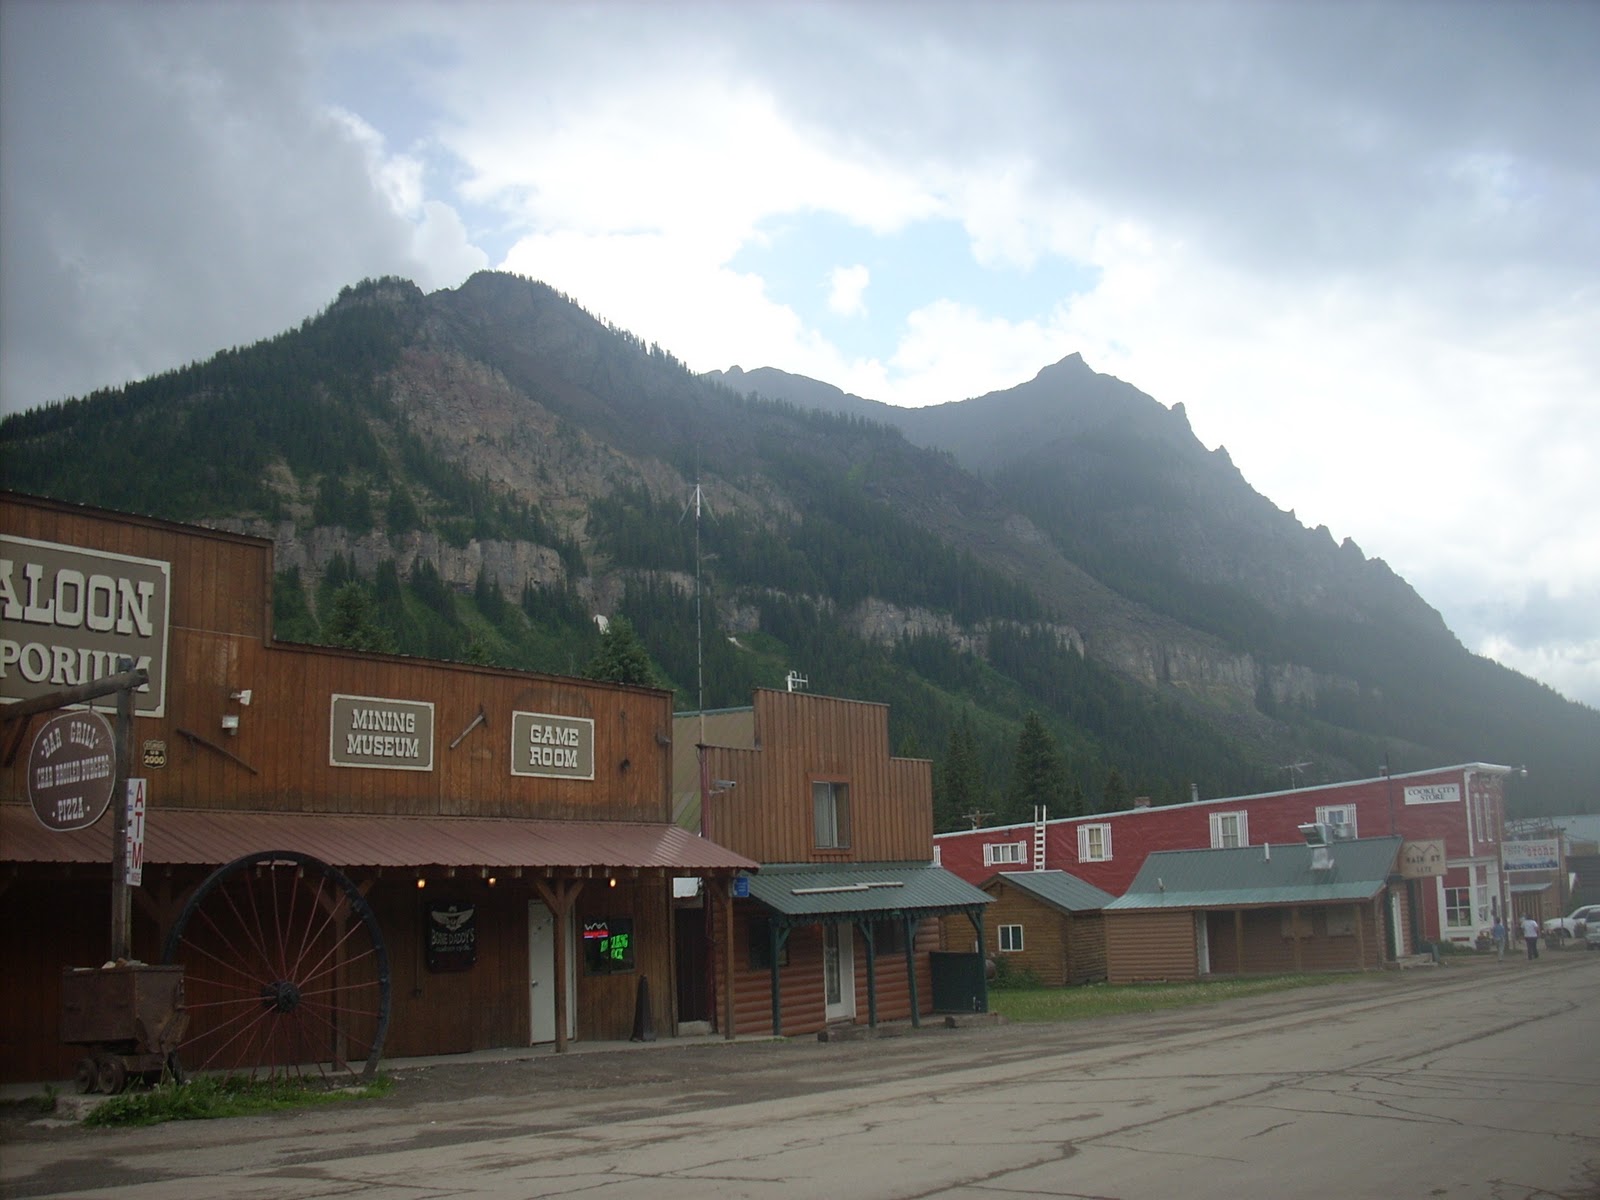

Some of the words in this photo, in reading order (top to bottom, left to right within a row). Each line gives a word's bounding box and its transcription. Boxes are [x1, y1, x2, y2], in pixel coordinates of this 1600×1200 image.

[352, 709, 415, 733] MINING
[42, 727, 62, 759] BAR
[70, 721, 96, 749] GRILL
[347, 734, 419, 758] MUSEUM
[530, 725, 579, 747] GAME
[144, 755, 164, 764] 2000
[529, 747, 578, 768] ROOM
[1408, 788, 1434, 796] COOKE
[1437, 786, 1455, 794] CITY
[1420, 793, 1444, 801] STORE
[58, 797, 84, 822] PIZZA
[132, 781, 143, 869] ATM
[431, 929, 448, 946] BONE
